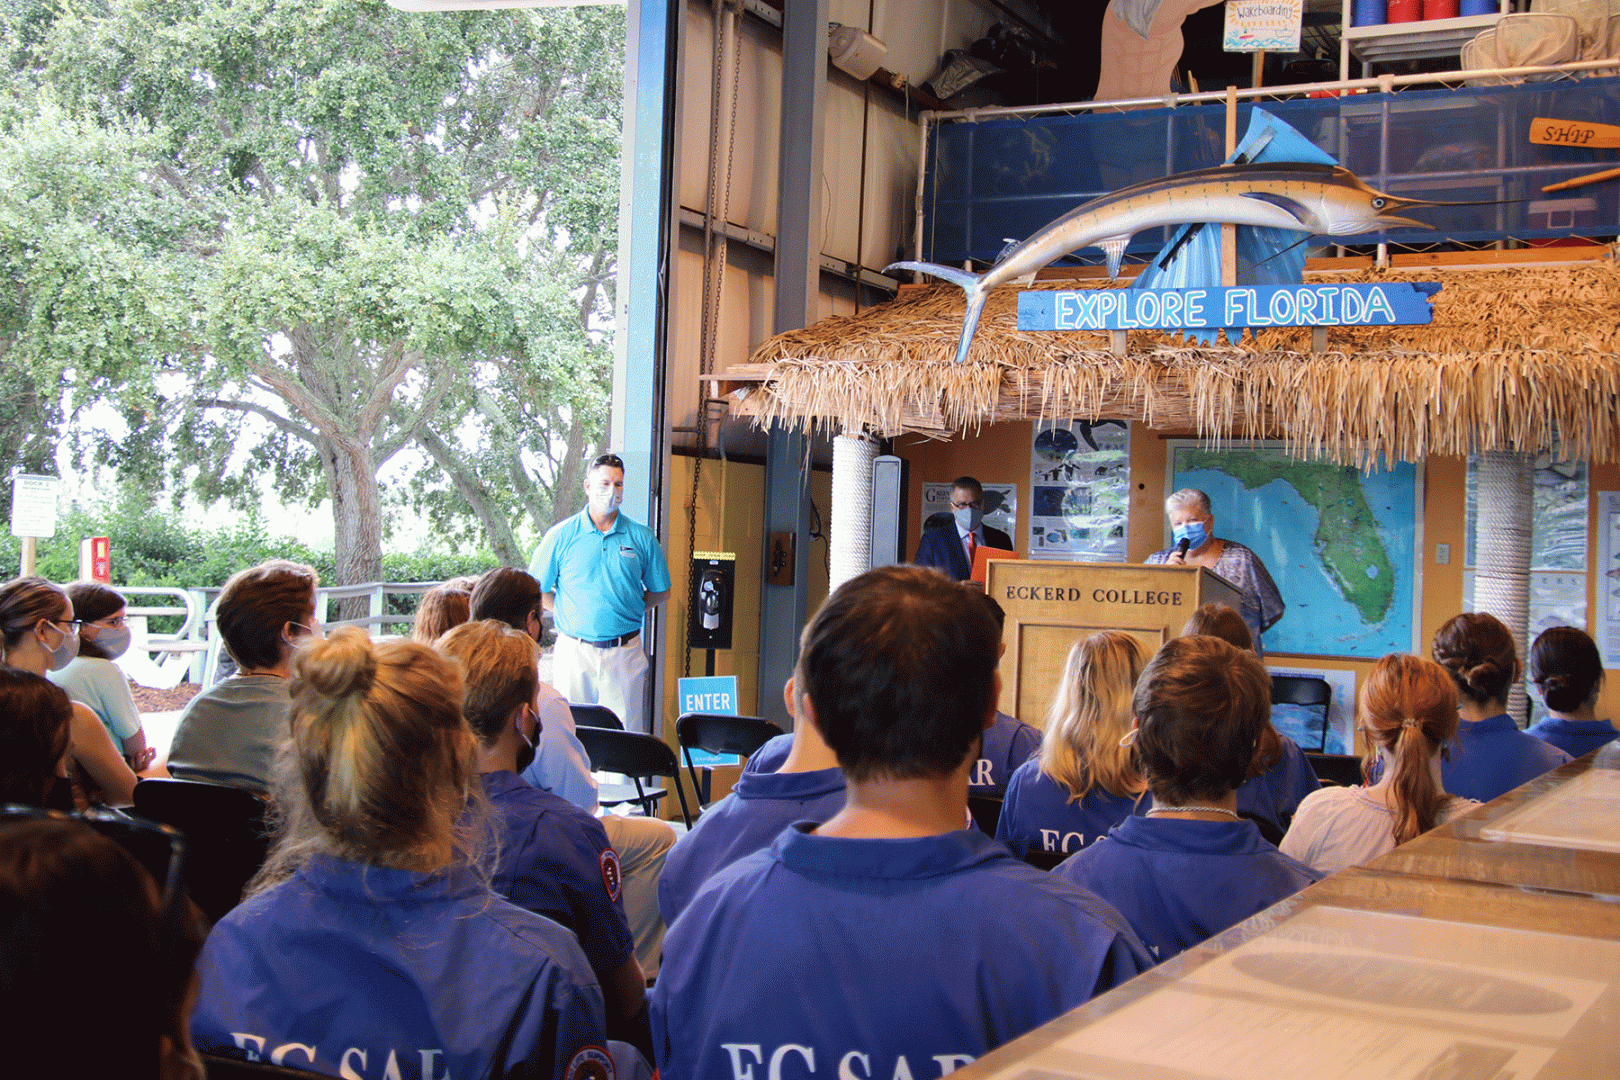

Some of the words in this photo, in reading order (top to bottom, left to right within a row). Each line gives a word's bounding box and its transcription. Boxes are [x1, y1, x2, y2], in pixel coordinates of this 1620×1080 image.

[1236, 4, 1293, 20] Wakeboarding
[1542, 124, 1596, 144] SHIP
[1055, 290, 1208, 330] EXPLORE
[1224, 286, 1397, 326] FLORIDA
[1006, 586, 1081, 602] ECKERD
[1092, 588, 1182, 606] COLLEGE
[686, 692, 731, 712] ENTER
